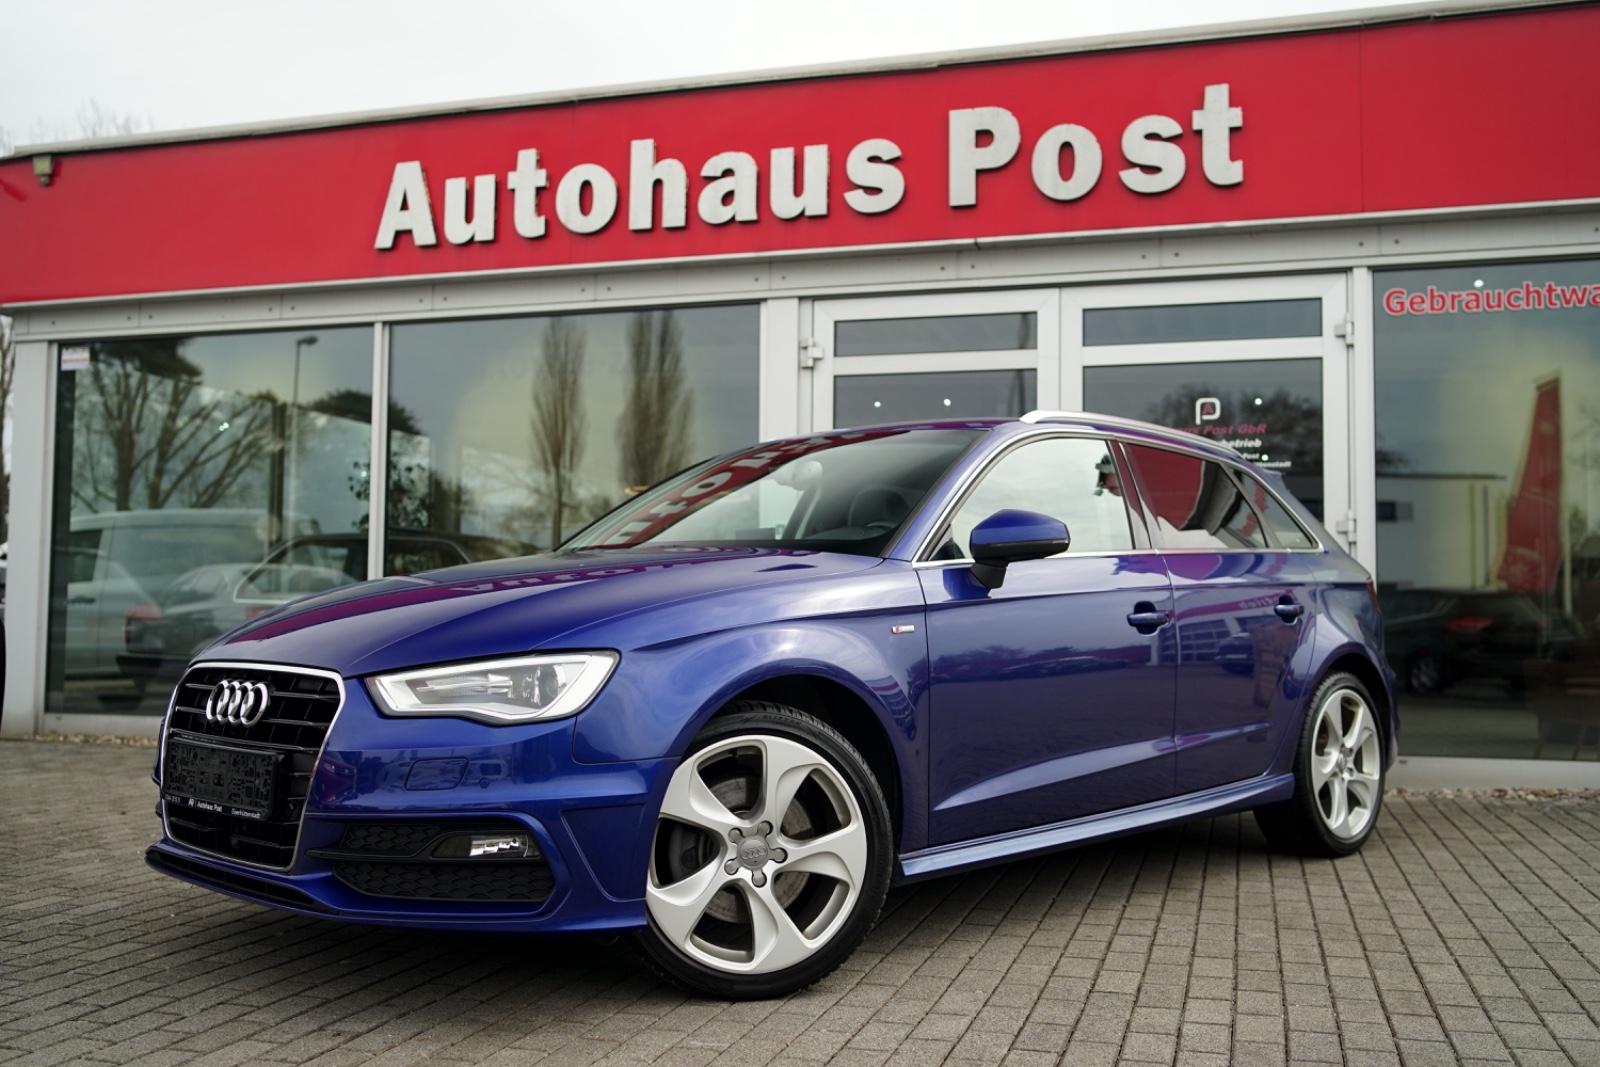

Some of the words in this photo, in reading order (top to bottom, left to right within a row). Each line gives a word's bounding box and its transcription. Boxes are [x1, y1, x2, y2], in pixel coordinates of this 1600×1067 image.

[374, 138, 906, 250] Autohaus
[948, 83, 1244, 207] Post
[1203, 424, 1233, 435] Post
[1238, 423, 1267, 434] GbR
[1220, 438, 1262, 448] betrieb
